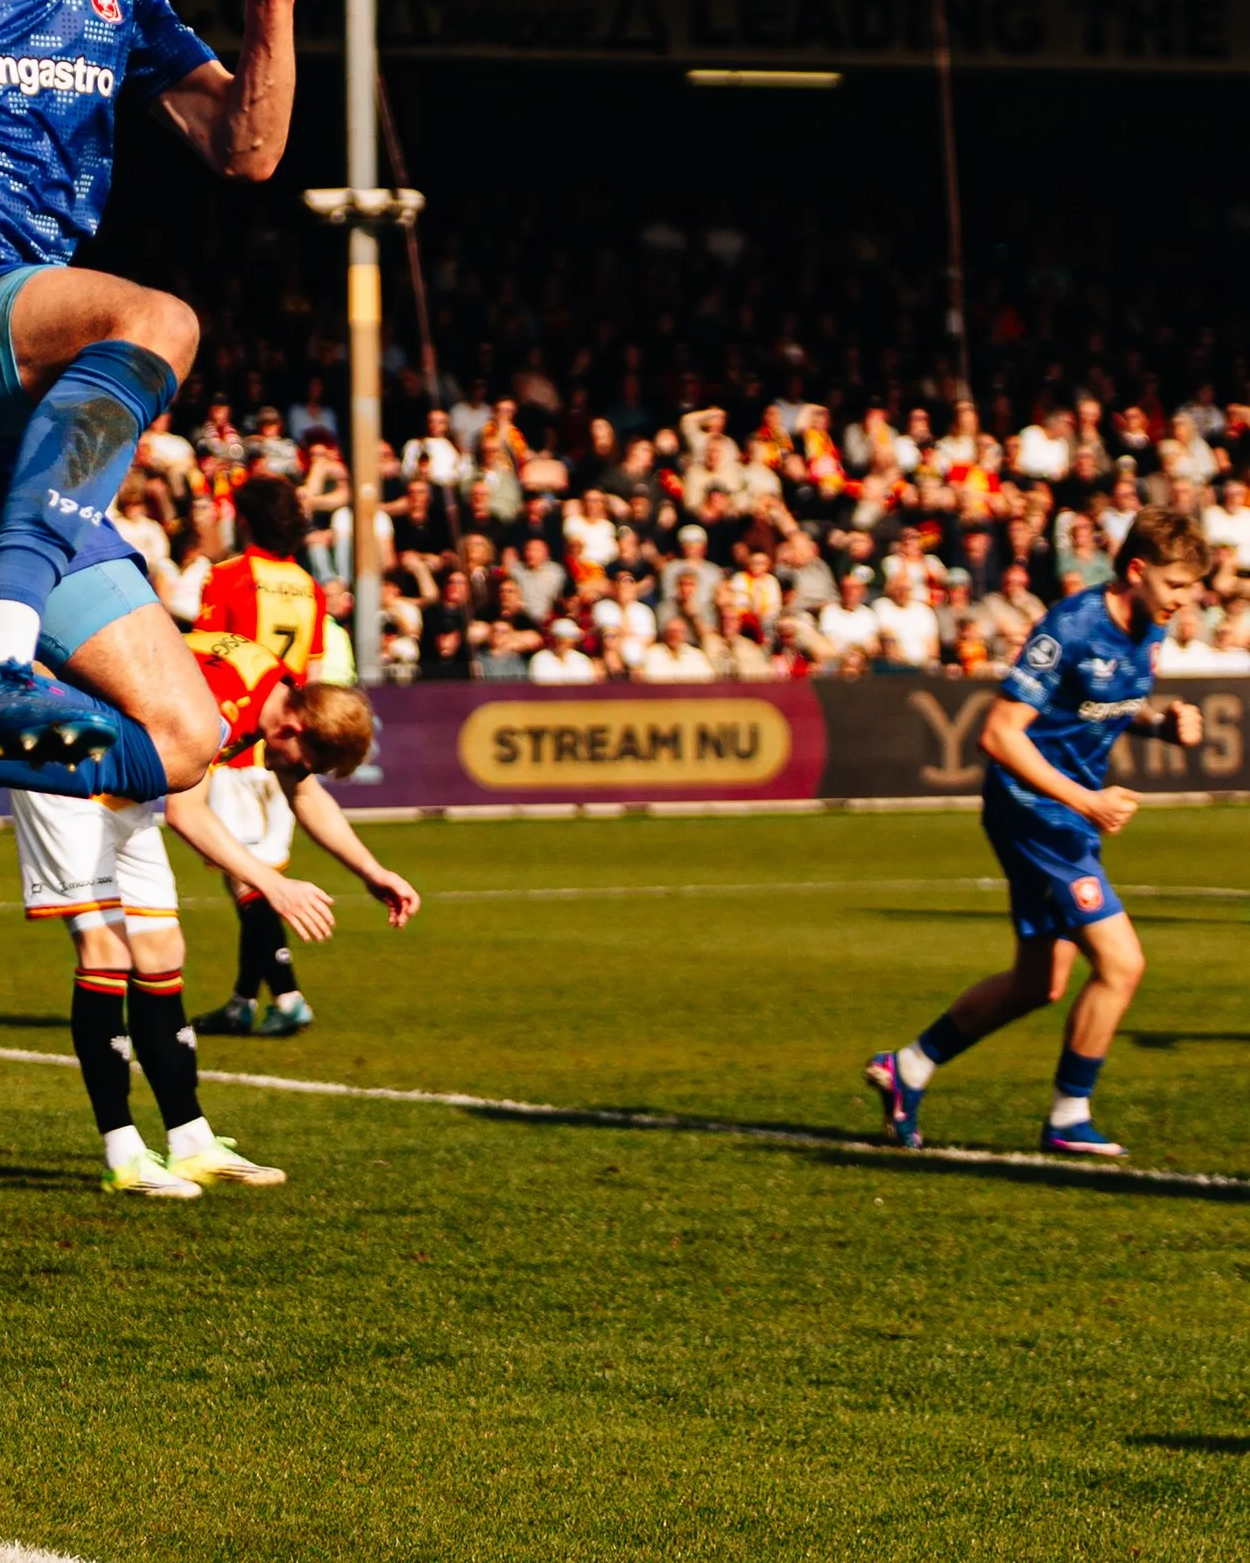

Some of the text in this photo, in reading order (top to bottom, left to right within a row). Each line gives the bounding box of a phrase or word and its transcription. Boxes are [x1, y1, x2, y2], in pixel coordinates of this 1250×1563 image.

[273, 624, 298, 659] 7
[492, 721, 761, 765] STREAM NU
